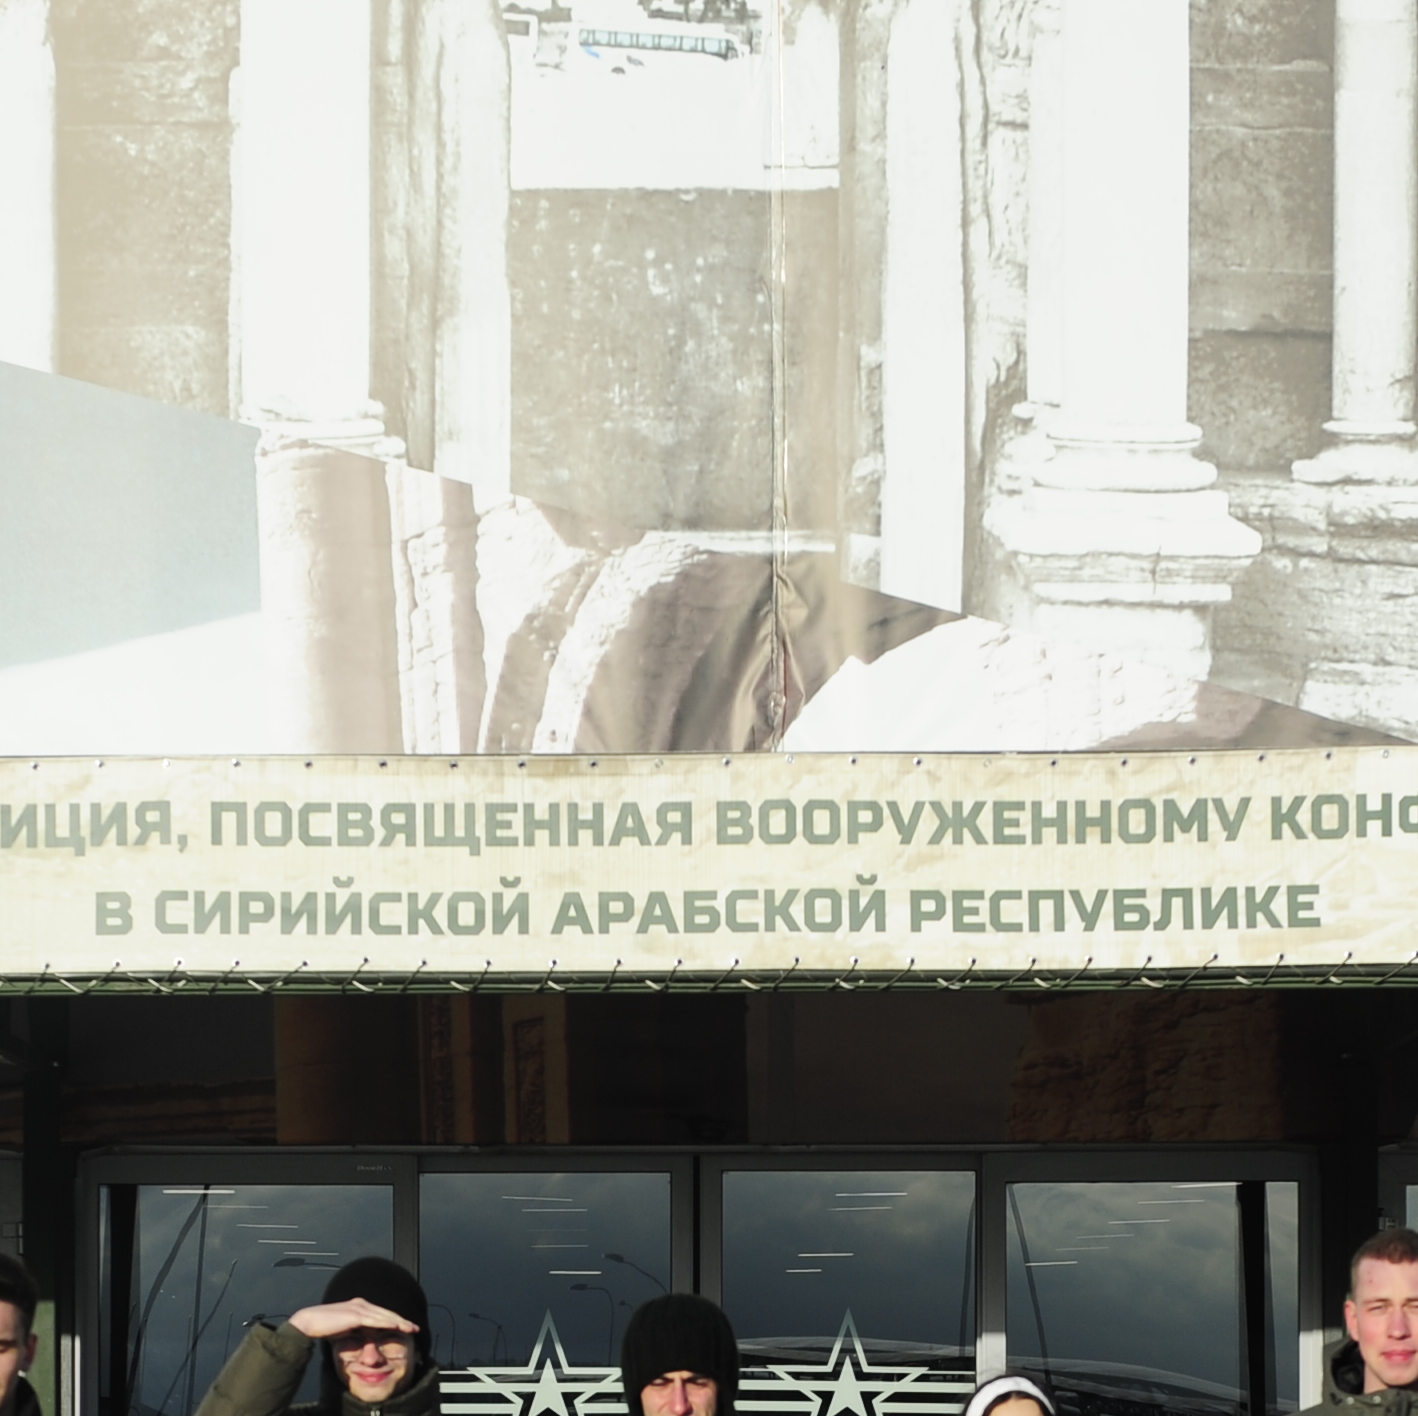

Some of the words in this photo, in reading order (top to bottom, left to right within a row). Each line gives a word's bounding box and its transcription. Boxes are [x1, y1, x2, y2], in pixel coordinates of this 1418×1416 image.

[210, 800, 693, 857] ПОСВЯЩЕННАЯ
[715, 796, 1253, 847] ВООРУЖЕННОМУ
[95, 891, 134, 936] В
[154, 875, 530, 937] СИРИЙСКОЙ
[550, 873, 887, 936] АРАБСКОЙ
[909, 884, 1322, 934] РЕСПУБЛИКЕ
